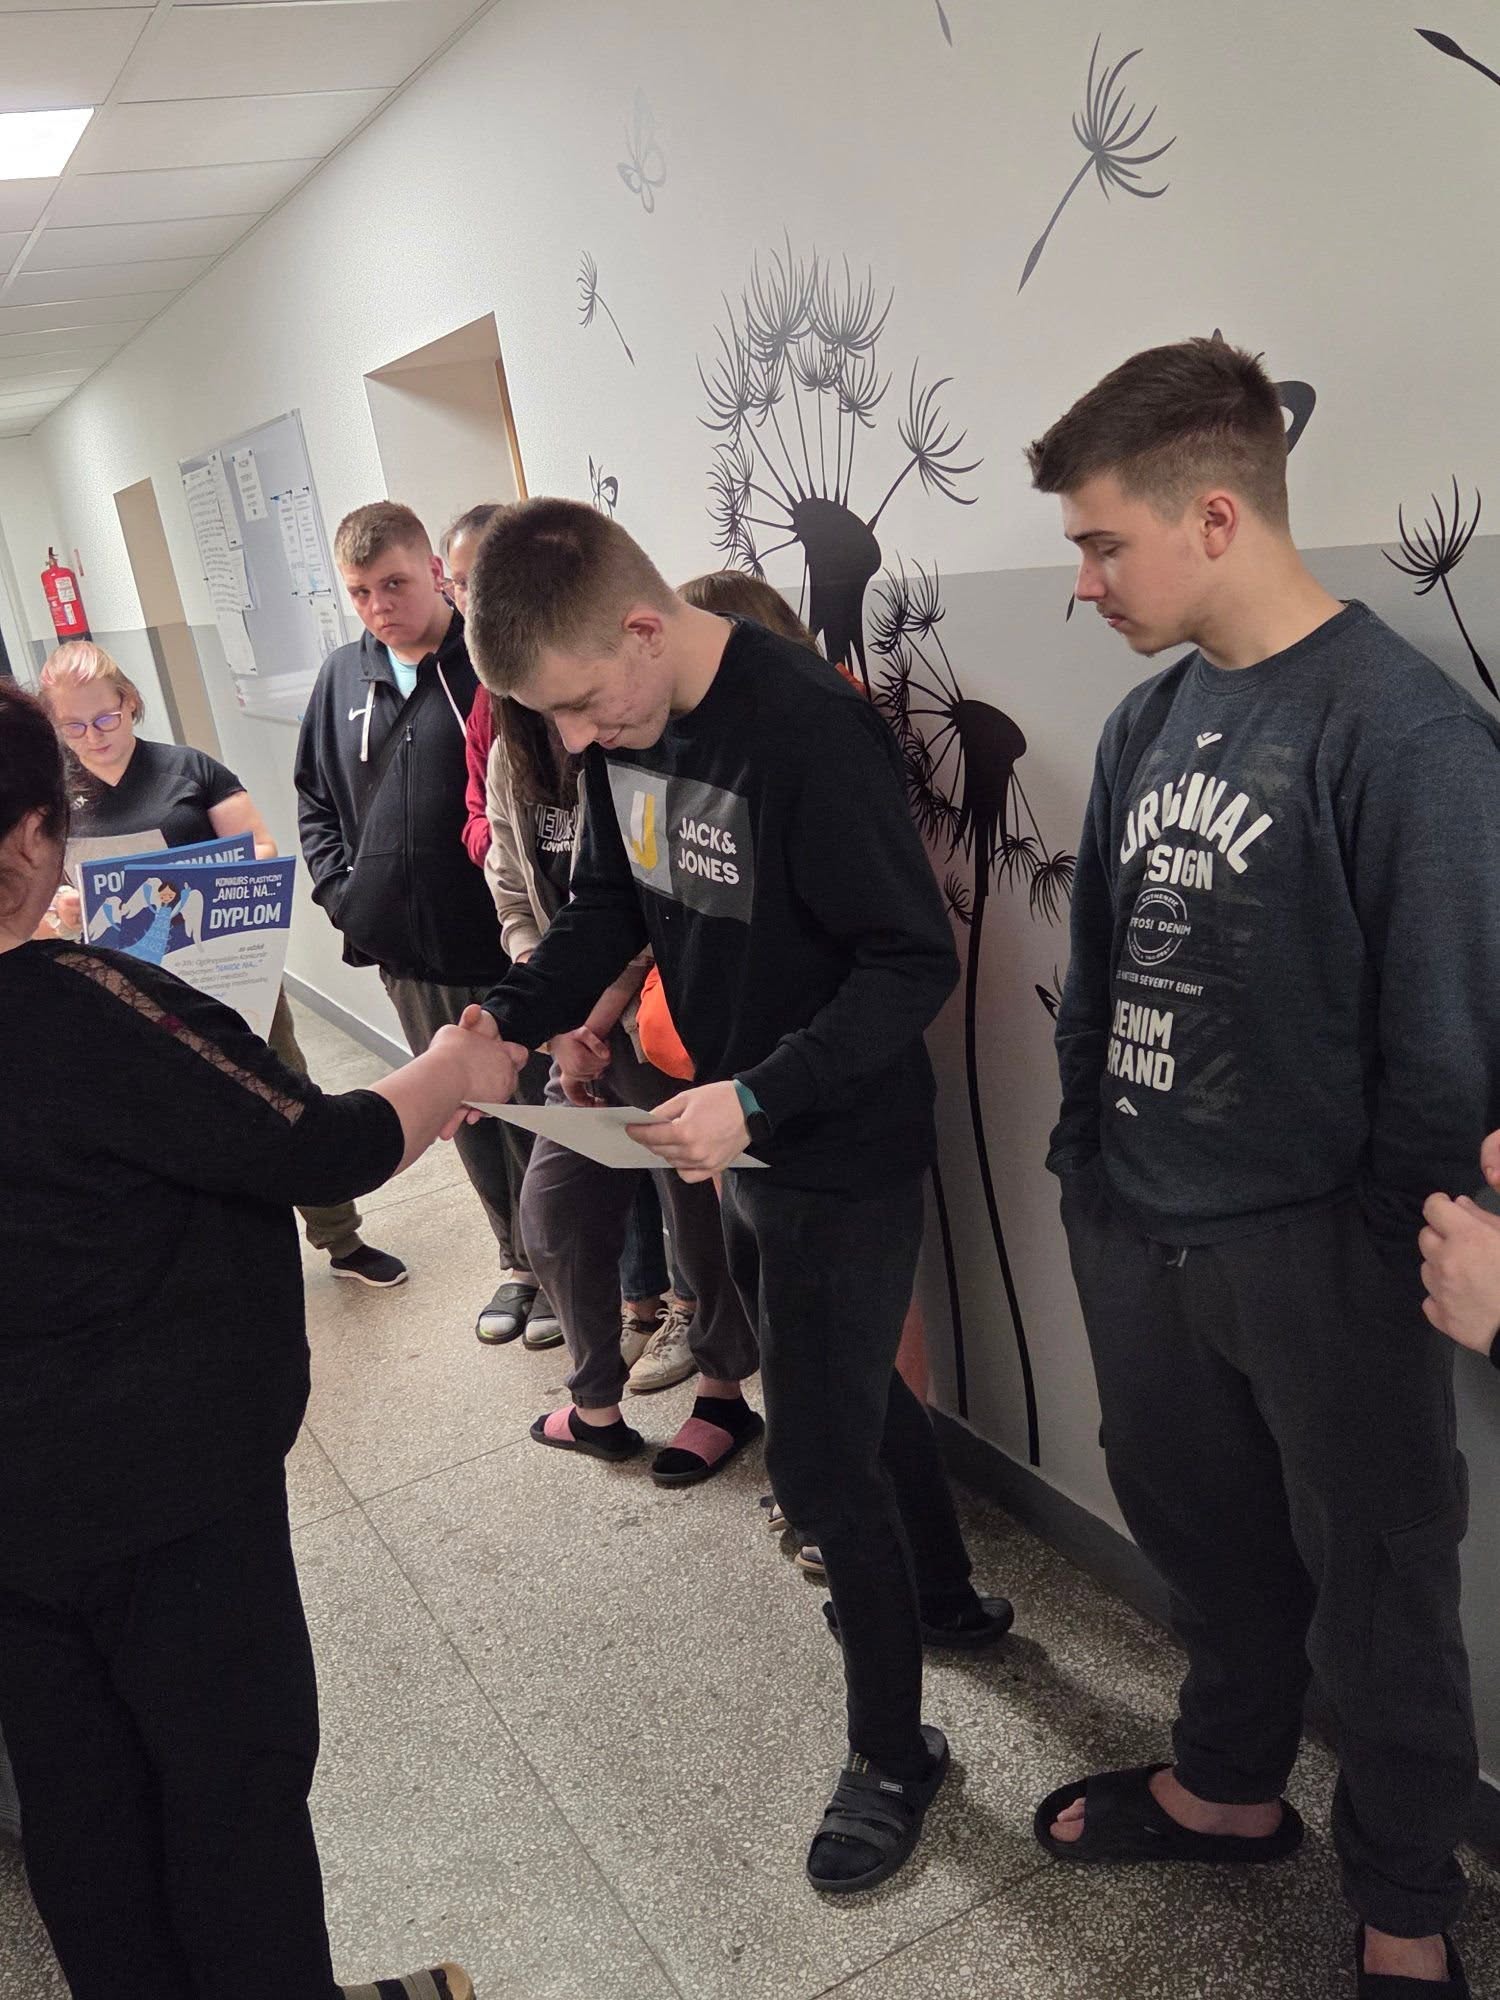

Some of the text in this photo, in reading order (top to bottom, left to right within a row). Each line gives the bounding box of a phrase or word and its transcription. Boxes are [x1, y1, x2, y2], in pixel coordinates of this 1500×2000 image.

[678, 817, 737, 855] JACK&
[678, 848, 740, 885] JONES
[1143, 844, 1214, 891] SIGN
[93, 870, 126, 895] PO
[215, 874, 283, 887] KONKURS PLASTYCZNY
[1142, 893, 1179, 908] AUTHENTIC
[209, 902, 282, 930] DYPLOM
[1157, 920, 1192, 936] DENIM
[1139, 974, 1175, 990] SEVENTY
[1175, 981, 1204, 997] EIGHT
